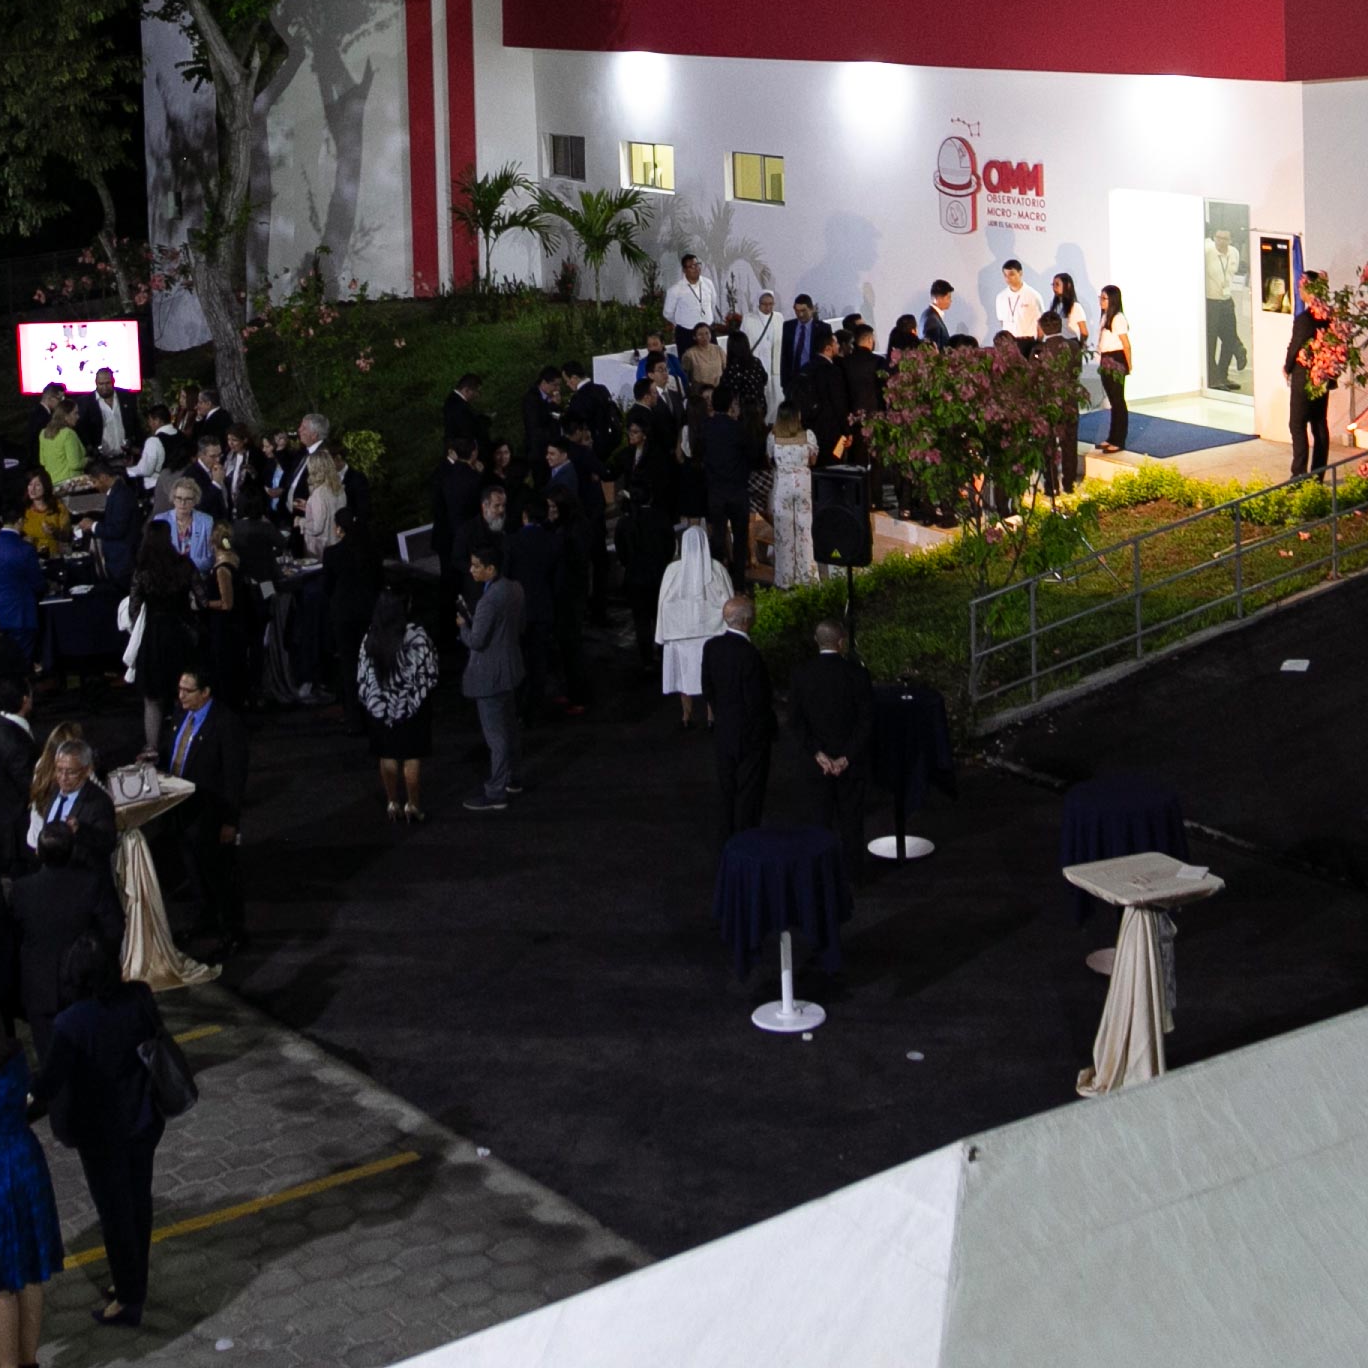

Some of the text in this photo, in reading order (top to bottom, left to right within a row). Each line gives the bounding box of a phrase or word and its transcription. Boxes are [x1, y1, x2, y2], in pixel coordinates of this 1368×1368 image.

[983, 160, 1044, 197] OMM
[987, 194, 1046, 208] OBSERVATORIO
[987, 207, 1012, 218] MICRO
[1018, 211, 1047, 222] MACRO
[1005, 222, 1030, 231] SALVADOR
